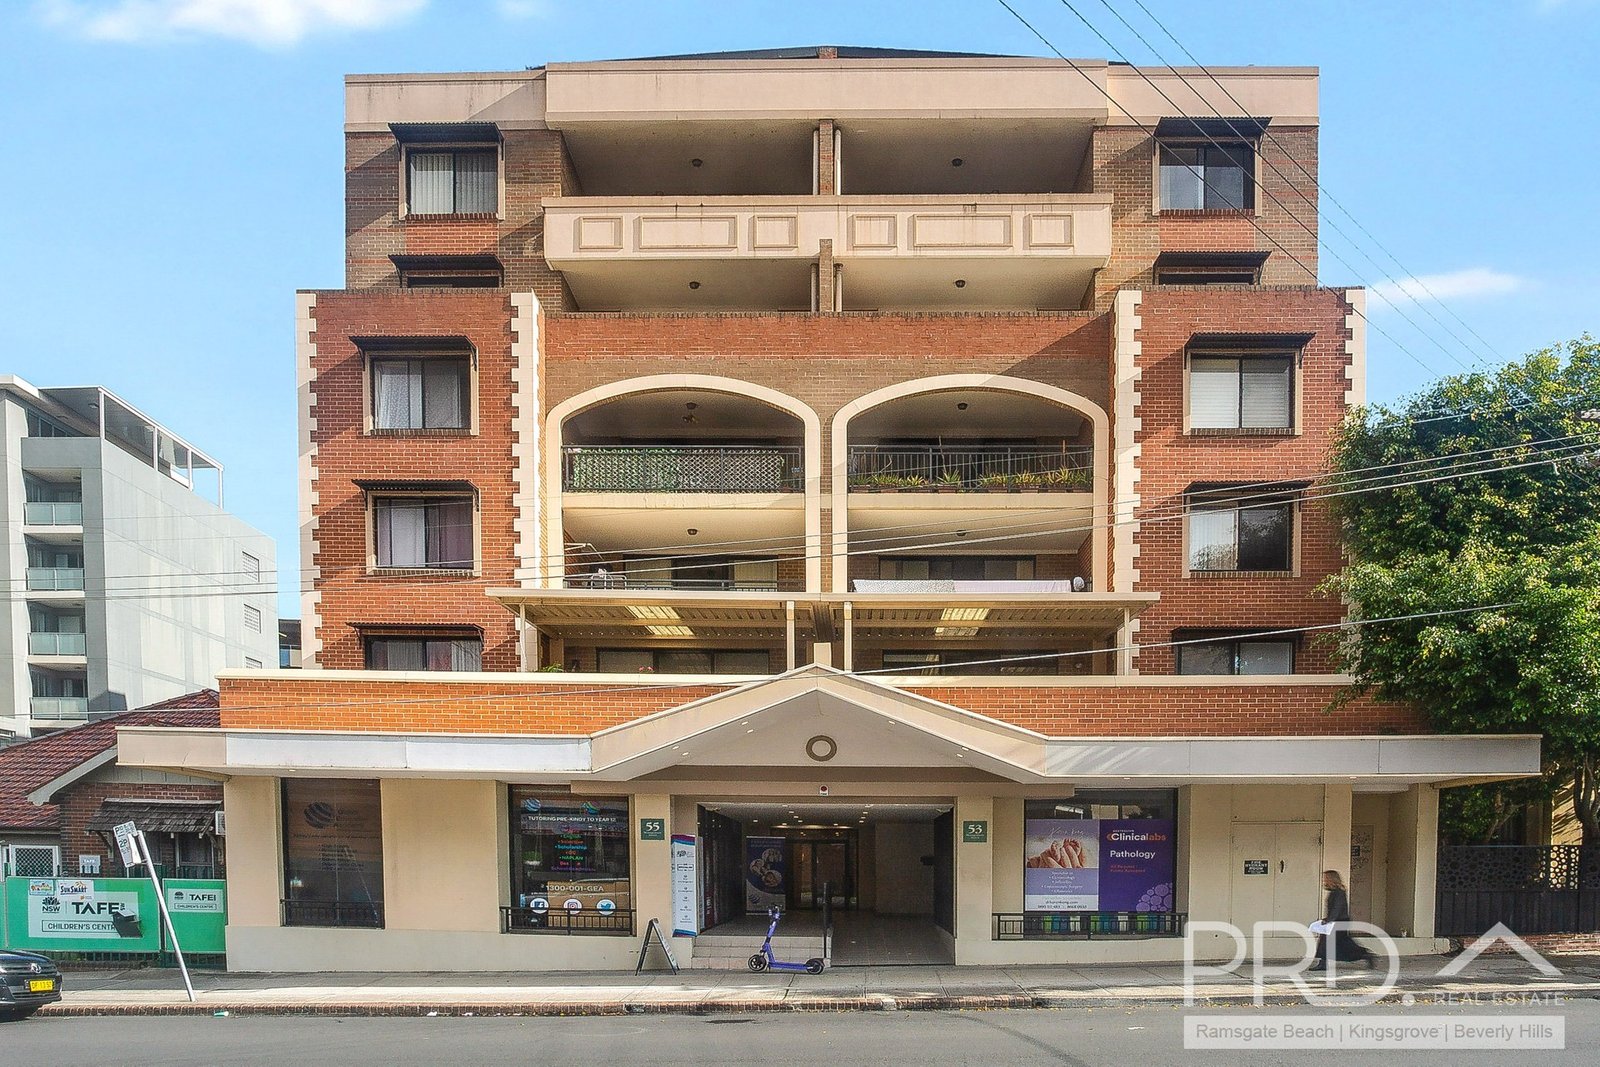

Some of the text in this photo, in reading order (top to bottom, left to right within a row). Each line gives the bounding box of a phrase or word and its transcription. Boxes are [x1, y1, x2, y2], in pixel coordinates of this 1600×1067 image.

[646, 822, 660, 832] 55
[968, 824, 982, 834] 53
[1111, 832, 1166, 841] Clinicalabs
[118, 838, 128, 848] 2P
[1110, 850, 1156, 860] Pathology
[72, 902, 119, 914] TAFE
